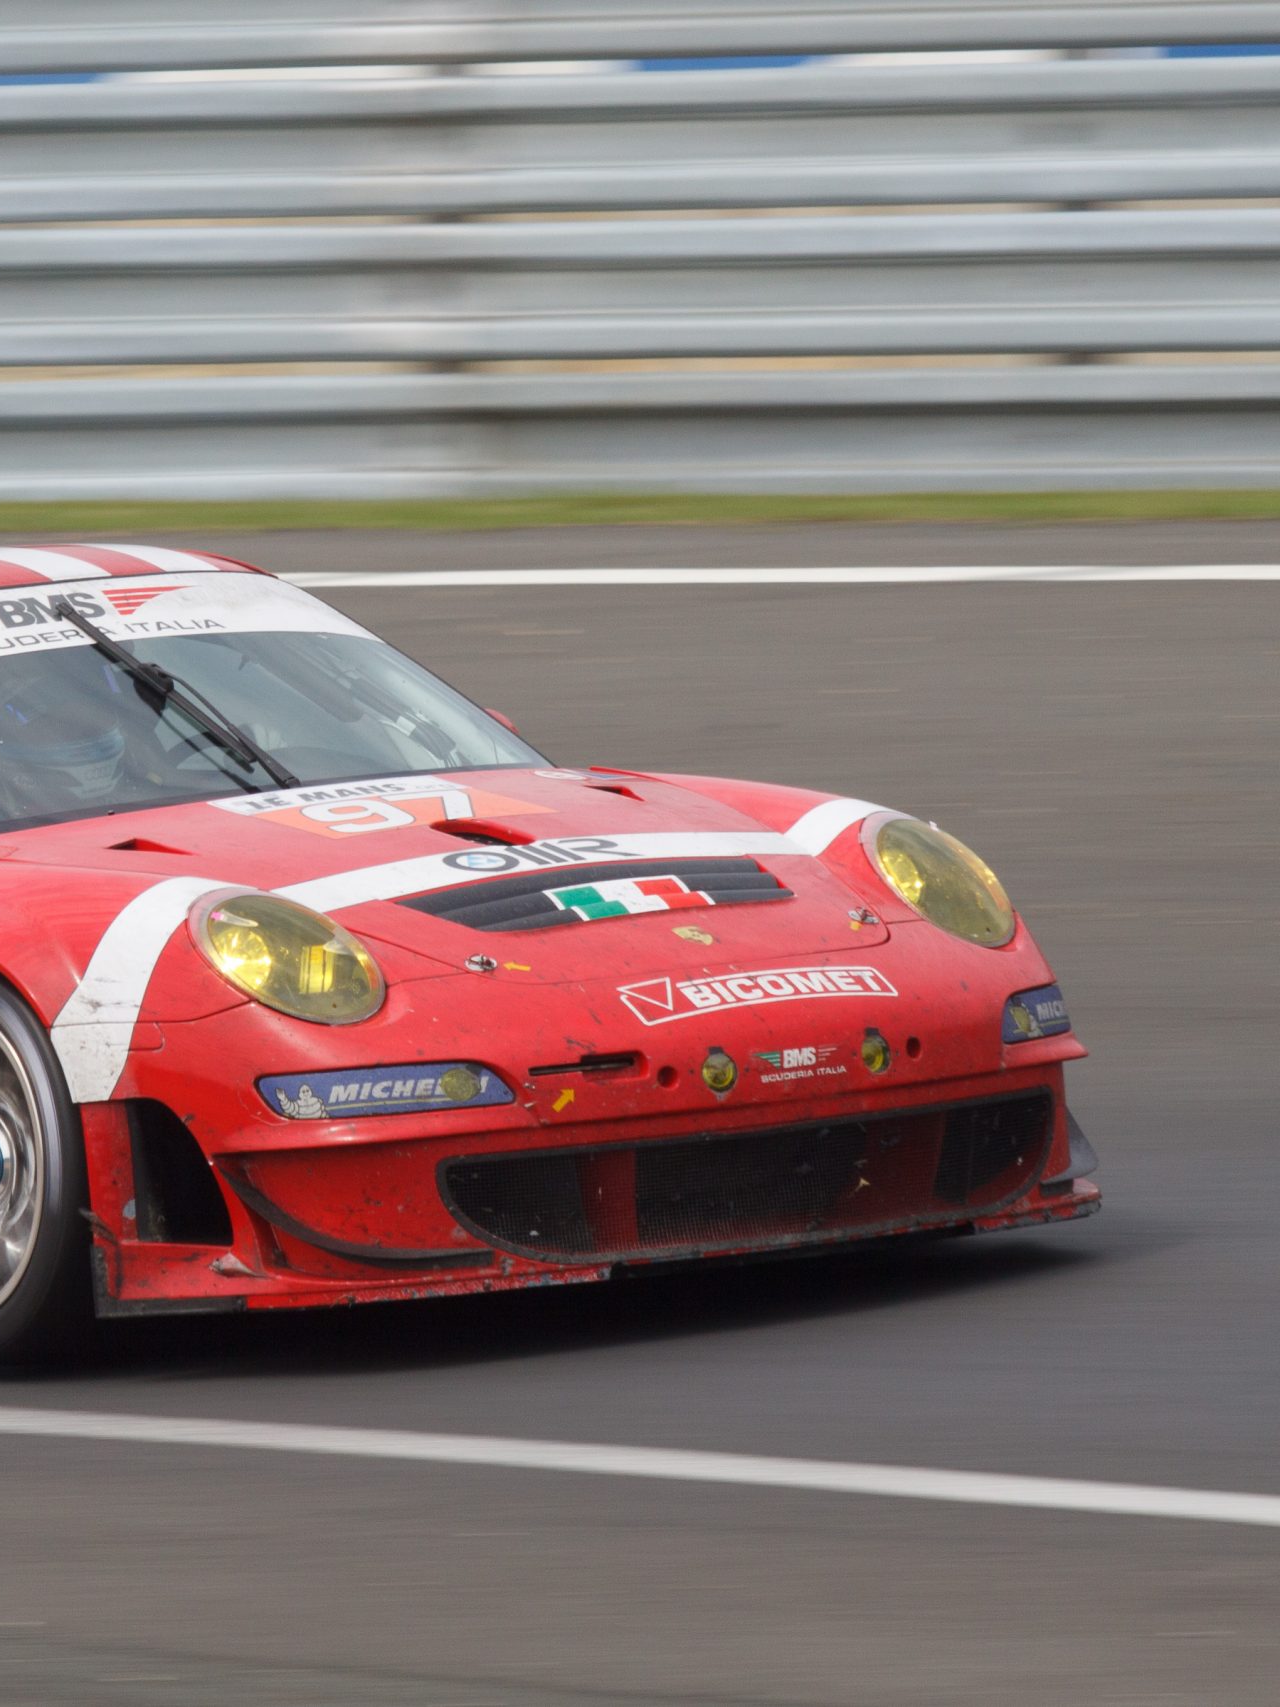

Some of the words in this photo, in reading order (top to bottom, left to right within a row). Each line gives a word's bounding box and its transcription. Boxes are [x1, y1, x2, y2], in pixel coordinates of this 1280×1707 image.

[125, 618, 226, 633] ITALIA
[298, 783, 406, 803] MANS
[299, 790, 474, 833] 97
[679, 970, 882, 1008] BICOMET
[782, 1046, 817, 1069] BMS
[760, 1069, 815, 1084] SCUDERIA
[816, 1065, 848, 1077] ITALIA
